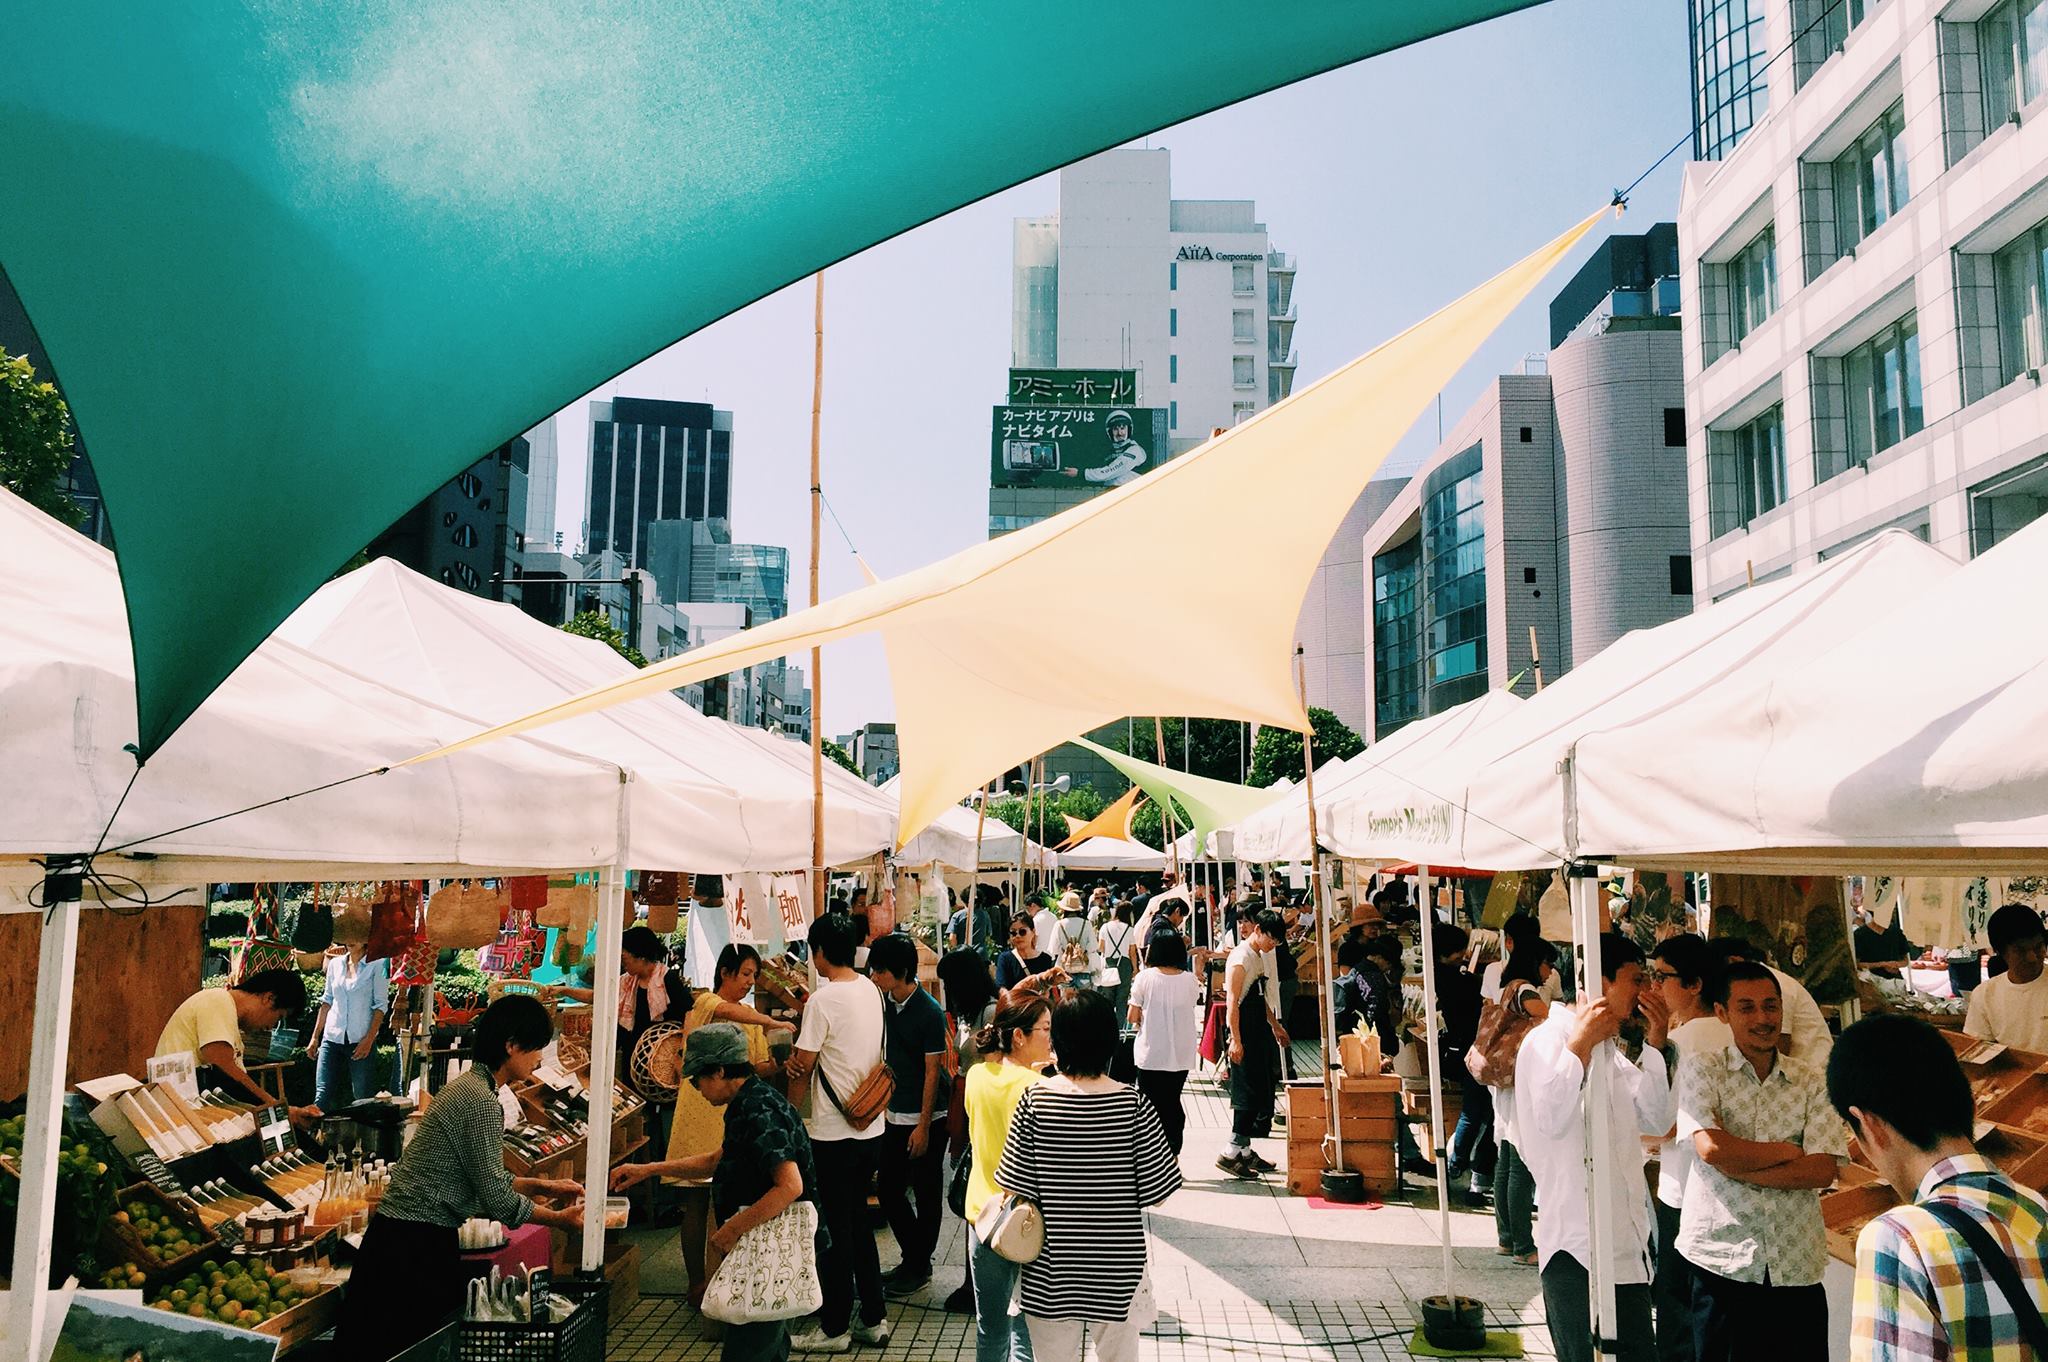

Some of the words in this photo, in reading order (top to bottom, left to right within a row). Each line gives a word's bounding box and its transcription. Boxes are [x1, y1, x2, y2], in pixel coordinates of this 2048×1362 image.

[1215, 252, 1263, 261] Corporation
[1002, 409, 1095, 423] カーナビアプリは
[1002, 424, 1072, 439] ナビタイム
